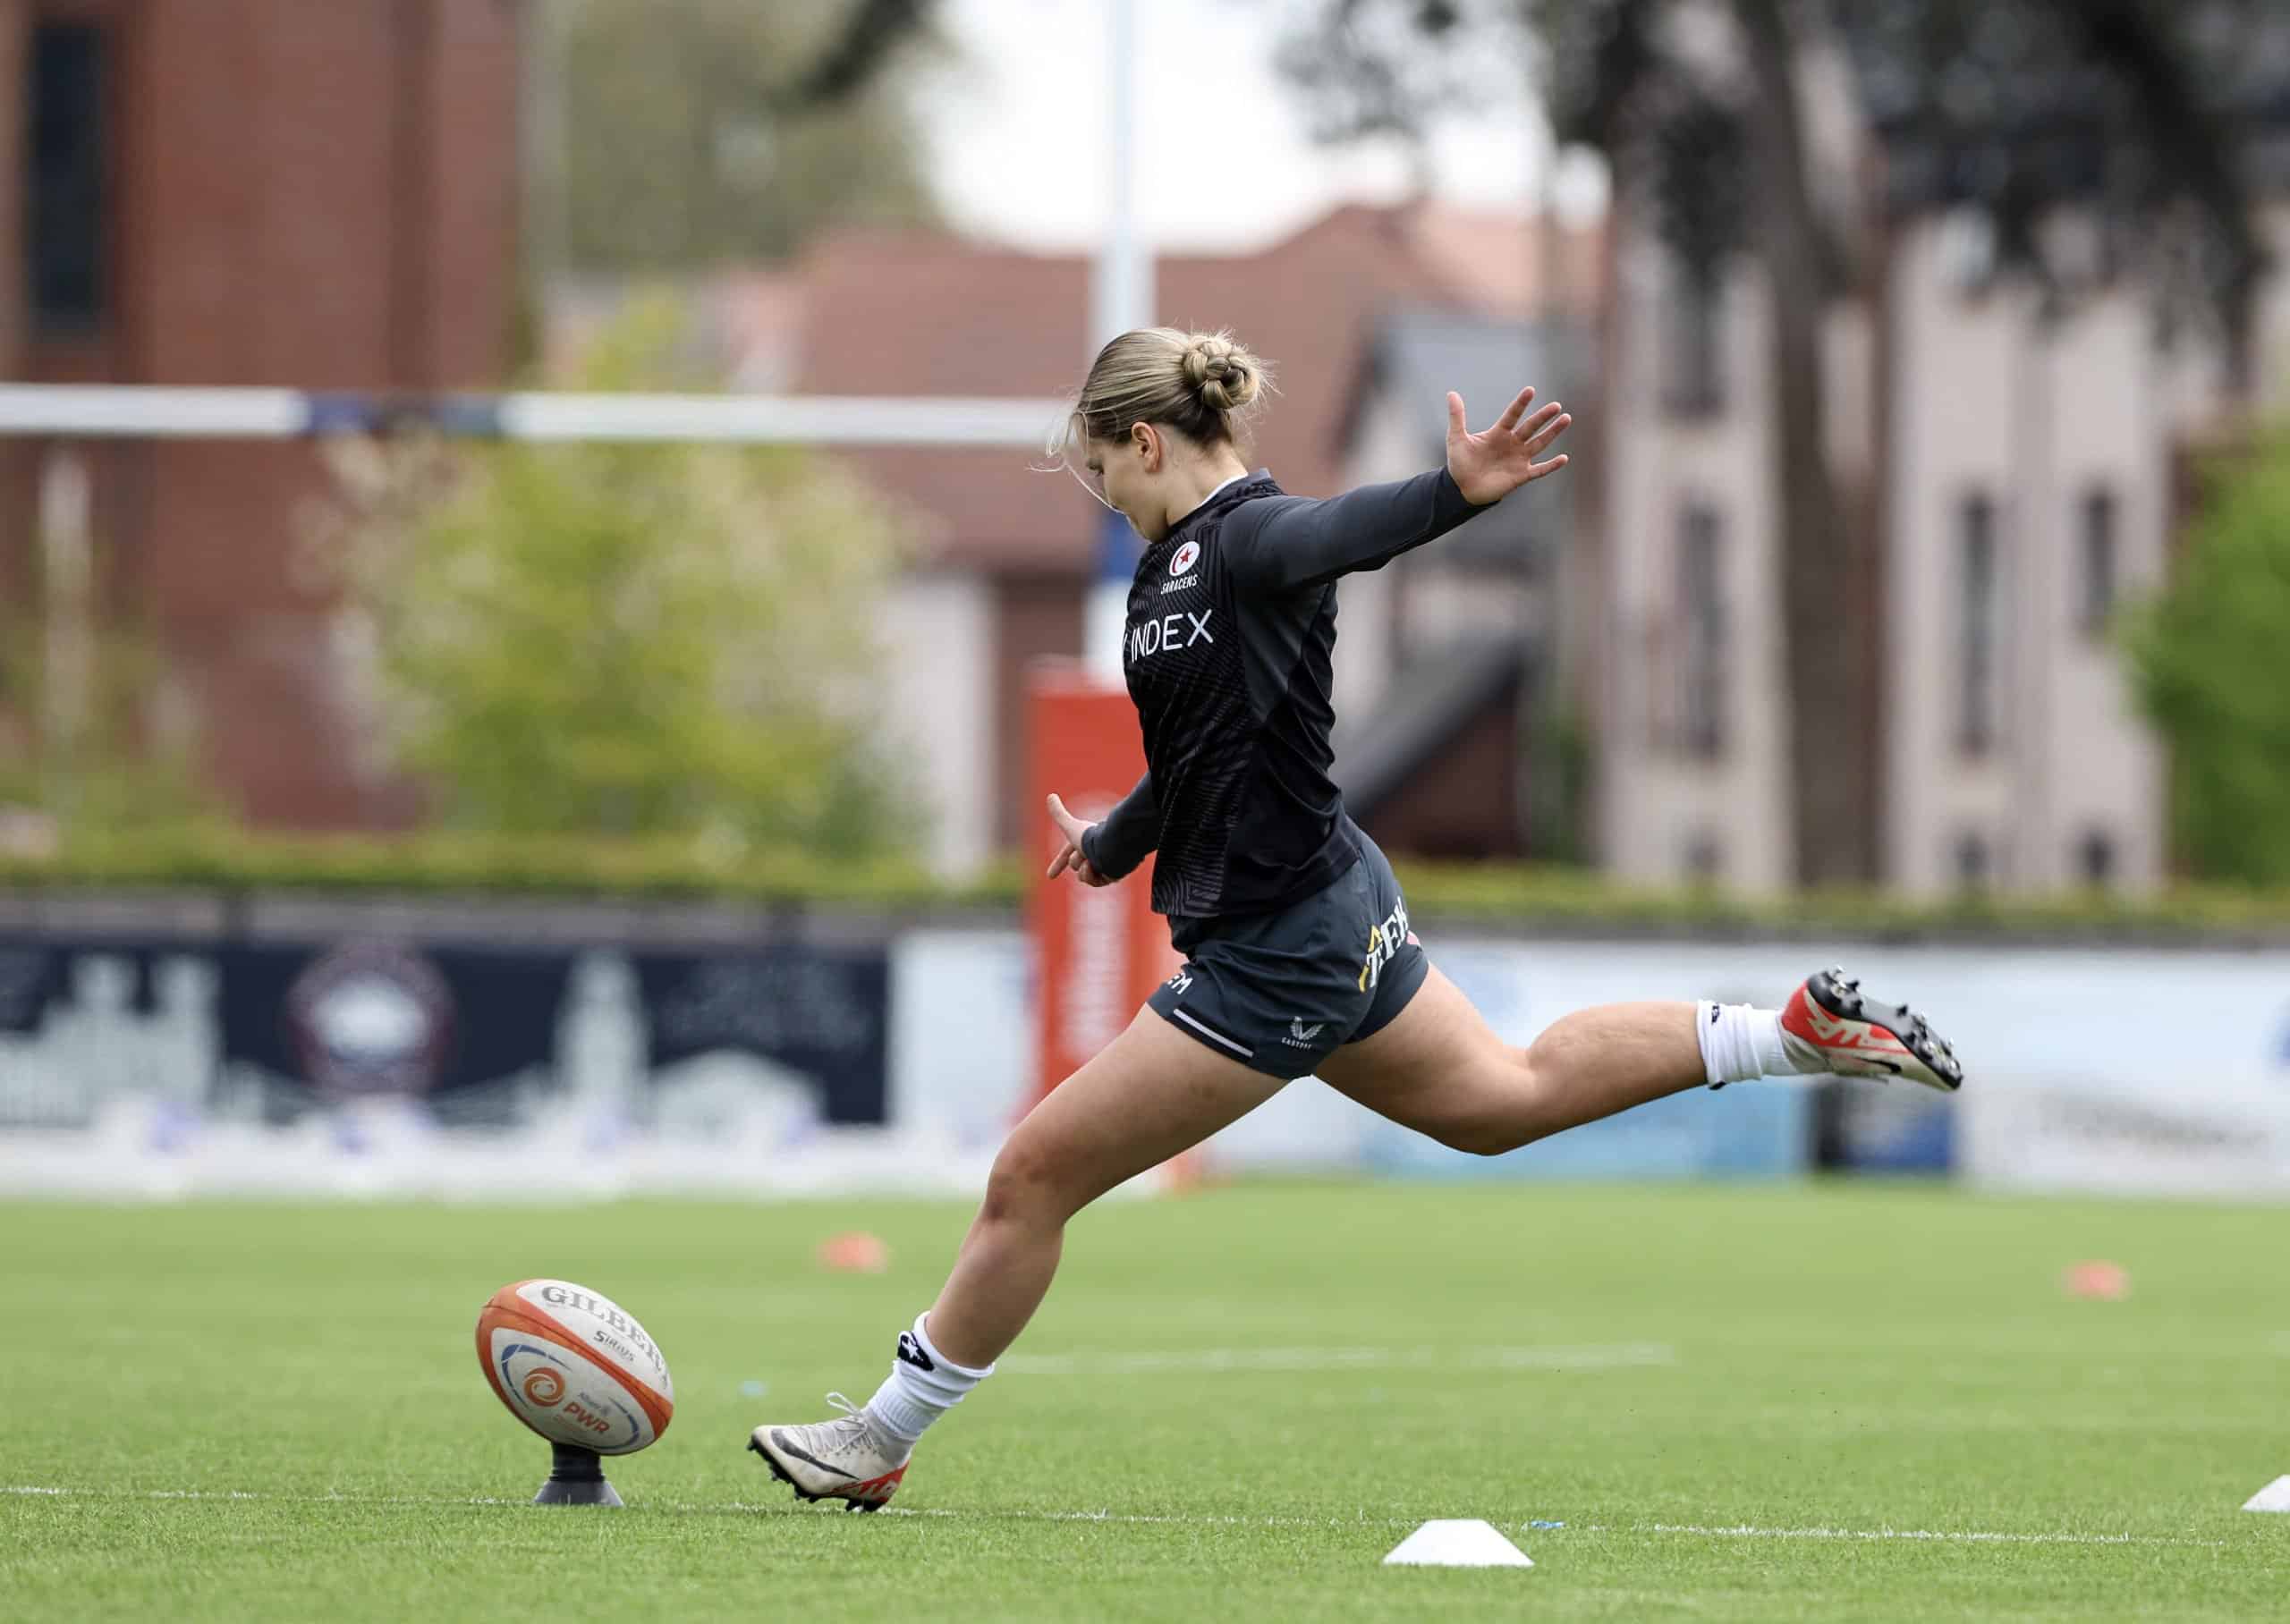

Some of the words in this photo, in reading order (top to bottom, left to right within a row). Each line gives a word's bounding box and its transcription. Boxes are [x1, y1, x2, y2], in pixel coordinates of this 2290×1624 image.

[1160, 573, 1199, 596] SARACENS
[1131, 609, 1214, 664] INDEX
[564, 1401, 610, 1435] PWR
